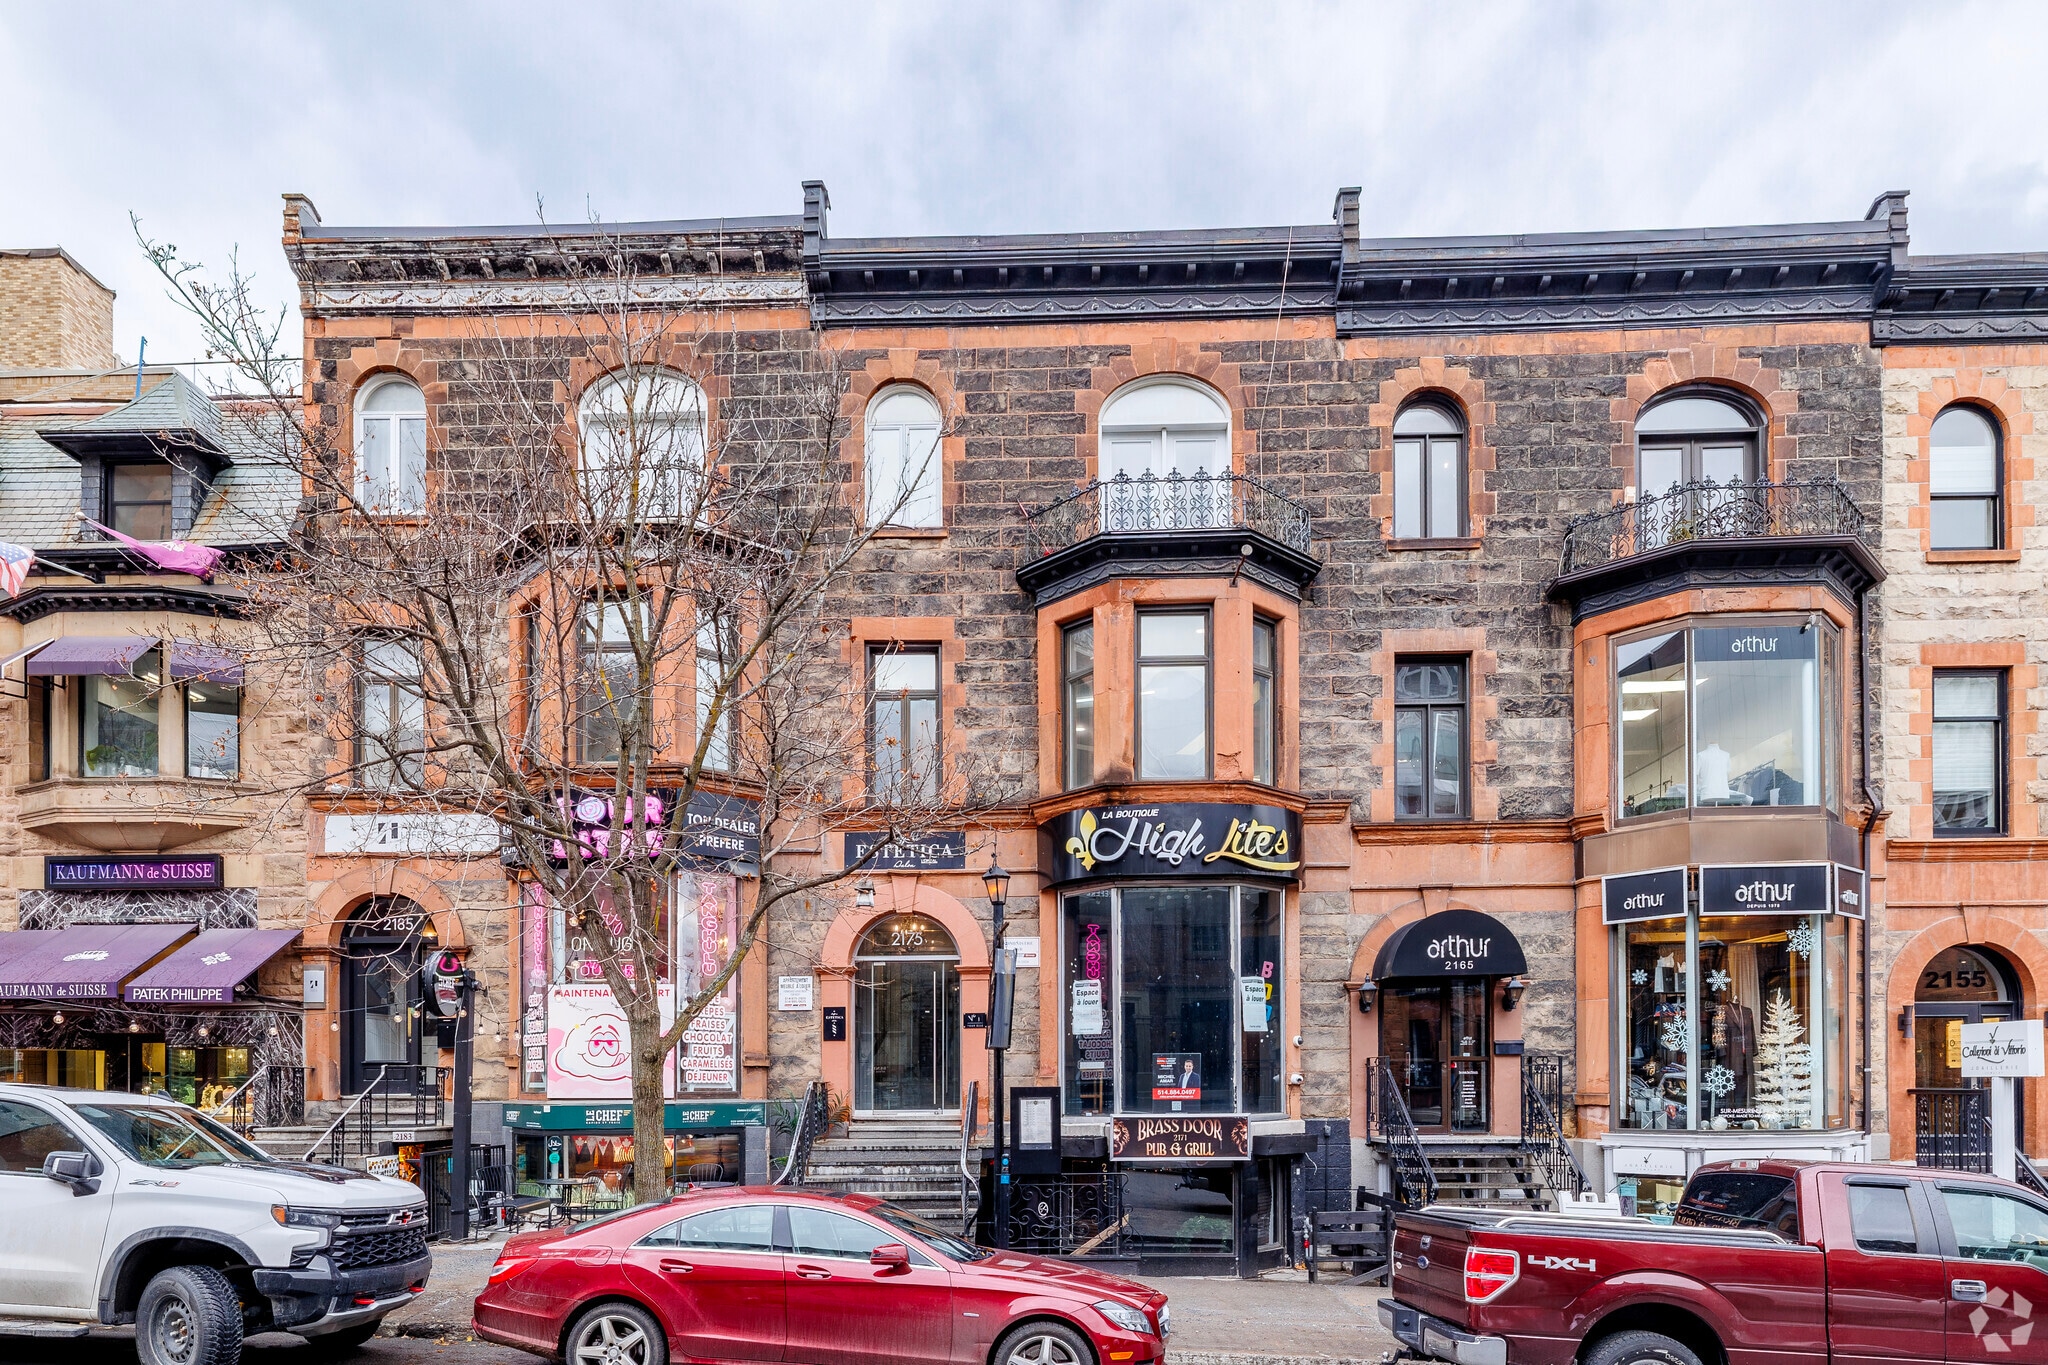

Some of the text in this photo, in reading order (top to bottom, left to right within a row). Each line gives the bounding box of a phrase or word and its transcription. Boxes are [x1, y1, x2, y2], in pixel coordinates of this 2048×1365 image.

[1731, 635, 1779, 653] arthur
[1102, 808, 1160, 820] LA BOUTIQUE
[715, 817, 756, 834] DEALER
[1091, 817, 1301, 871] High Lites
[55, 863, 212, 880] KAUFMANN de SUISSE
[1735, 880, 1795, 902] arthur
[1623, 892, 1665, 910] arthur
[383, 917, 414, 931] 2185
[891, 932, 923, 946] 2175
[1427, 935, 1491, 958] arthur
[1445, 961, 1474, 970] 2165
[1926, 971, 1986, 988] 2155
[56, 983, 67, 996] de
[69, 983, 107, 996] SUISSE
[133, 988, 222, 1001] PATEK PHILIPPE
[554, 989, 614, 998] MAINTENA
[1076, 990, 1099, 998] Espace
[691, 1020, 725, 1029] FRAISES
[684, 1032, 732, 1043] CHOCOLAT
[693, 1046, 723, 1055] FRUITS
[687, 1070, 728, 1081] DÉJEUNER
[595, 1110, 623, 1122] CHEF
[690, 1110, 710, 1120] CHEF
[395, 1132, 412, 1141] 2183
[1137, 1119, 1222, 1141] BRASS DOOR
[1146, 1142, 1167, 1156] PUB
[1184, 1142, 1215, 1156] GRILL
[1527, 1254, 1596, 1272] 4X4
